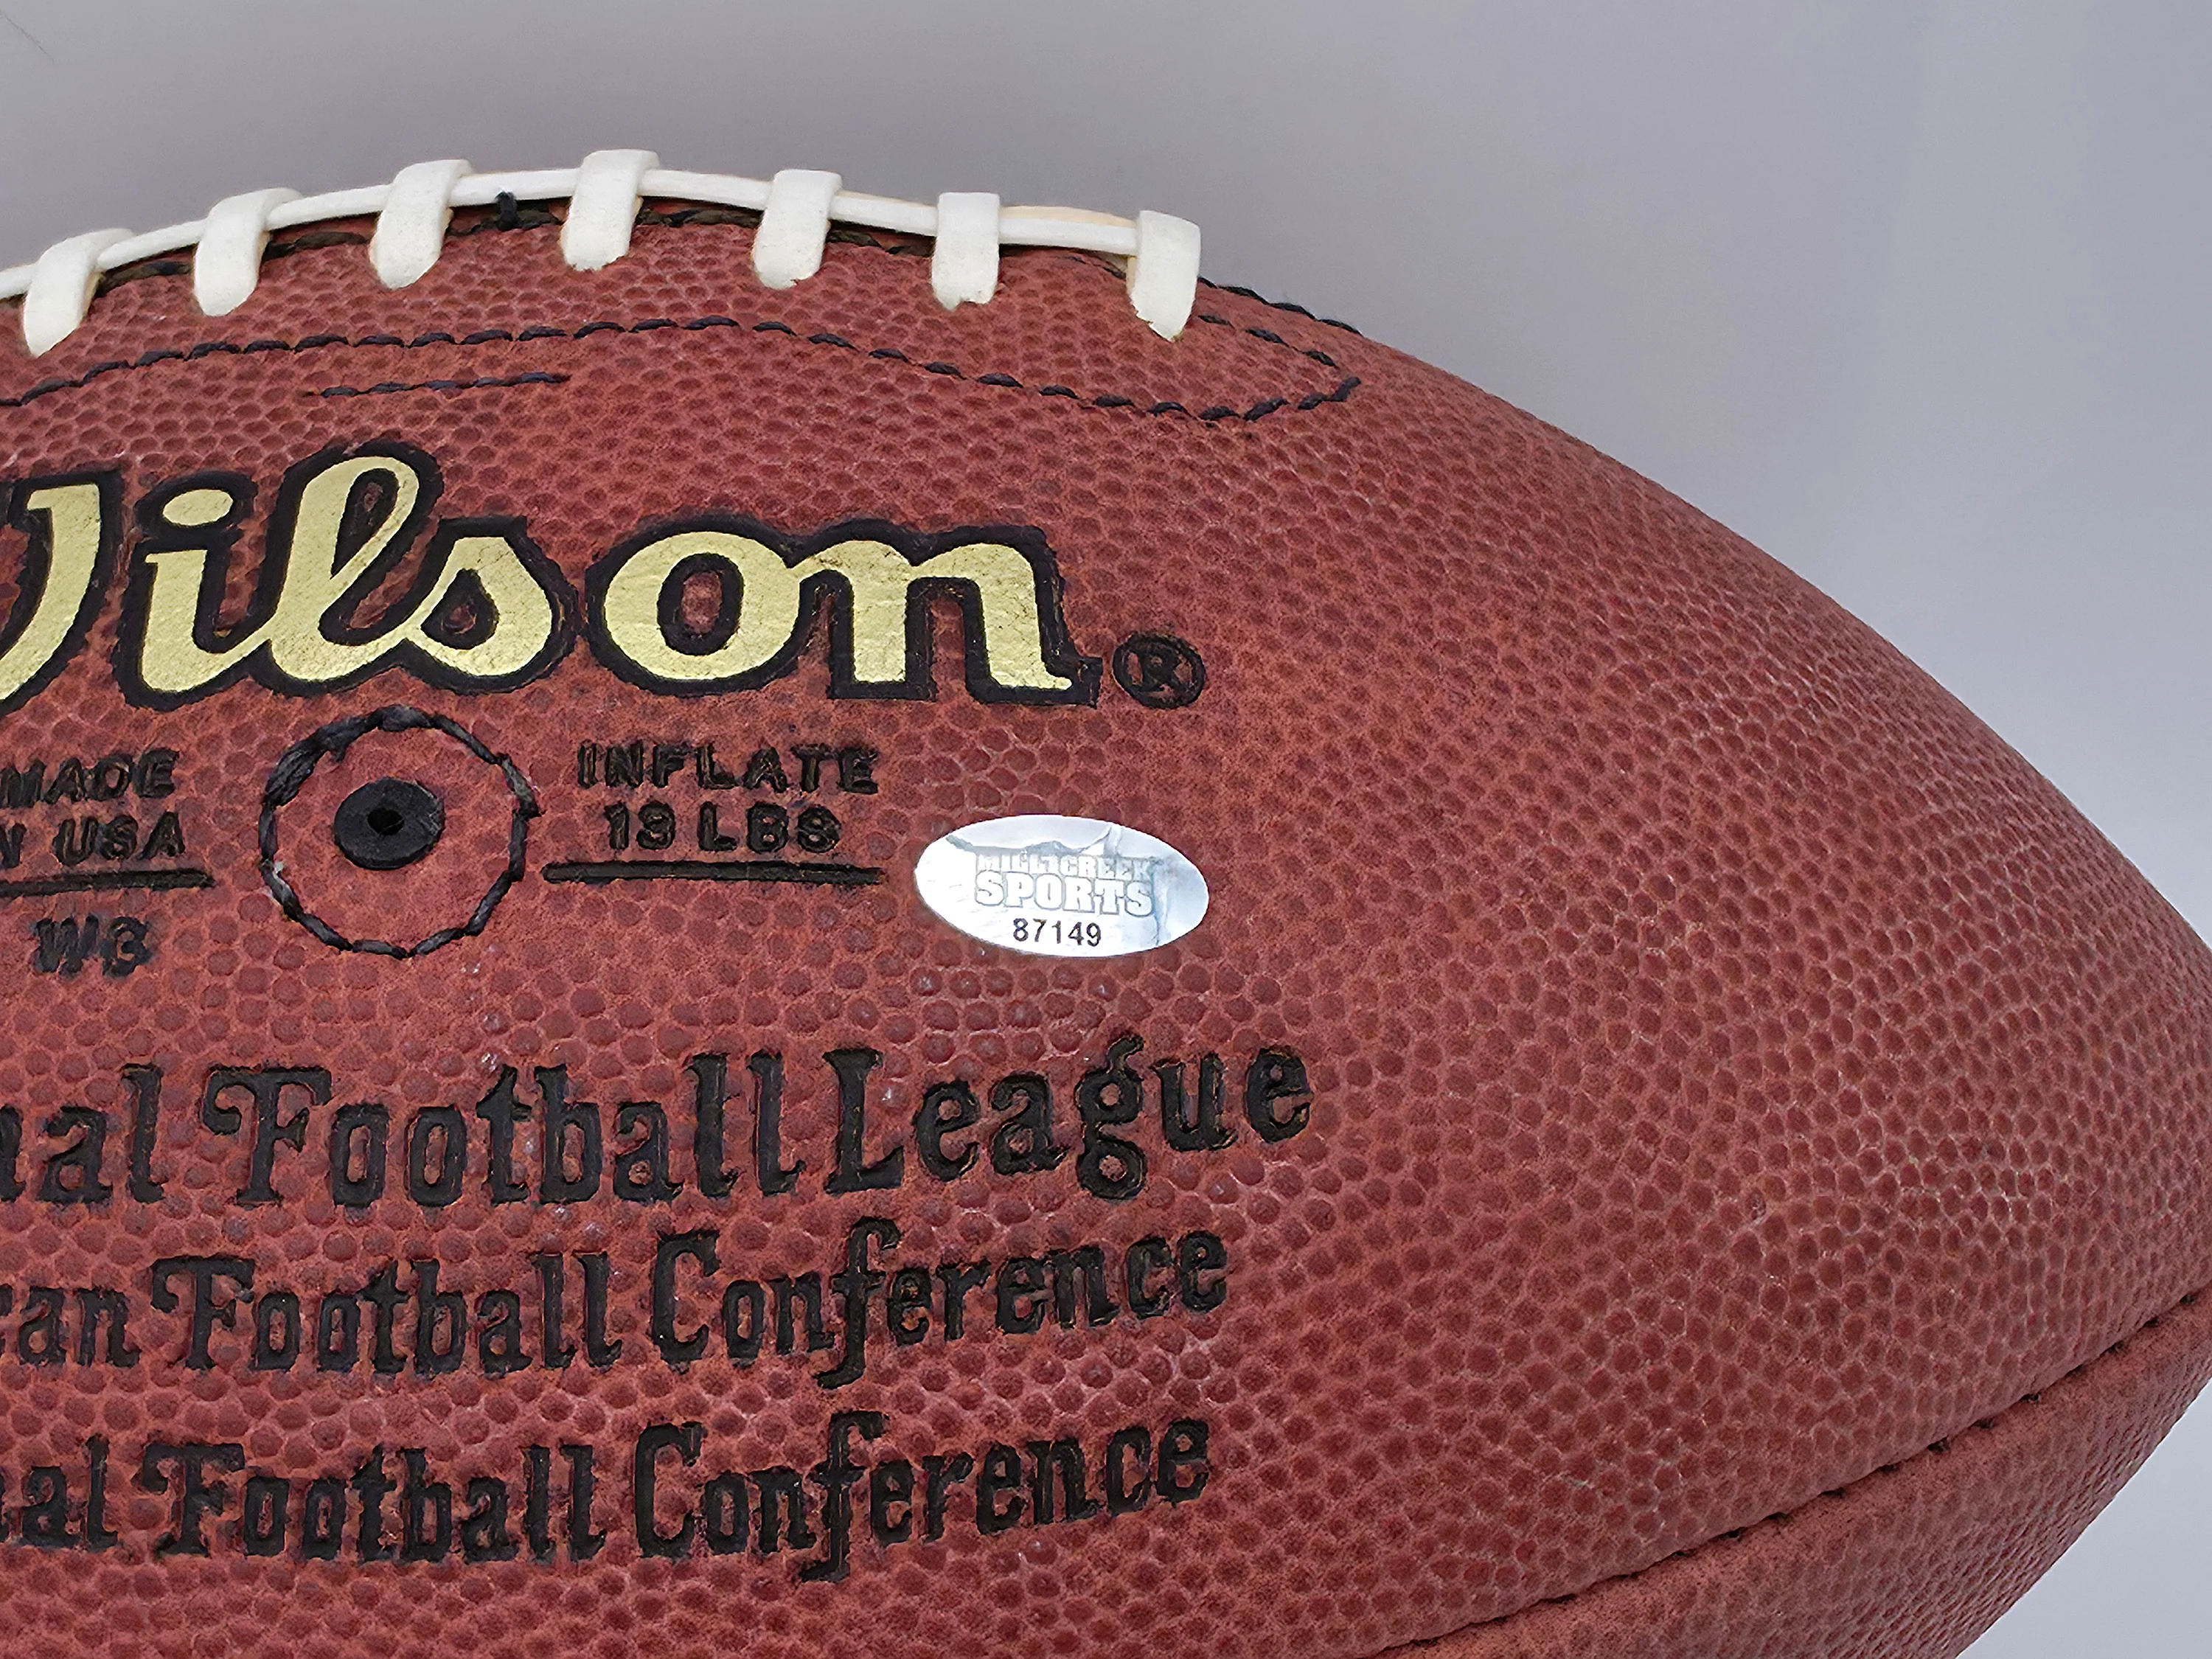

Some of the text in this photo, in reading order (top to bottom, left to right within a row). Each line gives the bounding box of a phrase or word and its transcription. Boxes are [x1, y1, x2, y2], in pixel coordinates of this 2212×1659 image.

[577, 739, 880, 794] INFLATE
[52, 812, 185, 866] USA
[697, 801, 842, 853] LBS
[975, 869, 1155, 918] SPORTS
[1012, 917, 1102, 947] 87149
[201, 1048, 804, 1207] Football
[820, 1034, 1315, 1200] League
[150, 1249, 622, 1374] Football
[649, 1215, 1228, 1389] Conference
[0, 1414, 1211, 1582] al Football Conference
